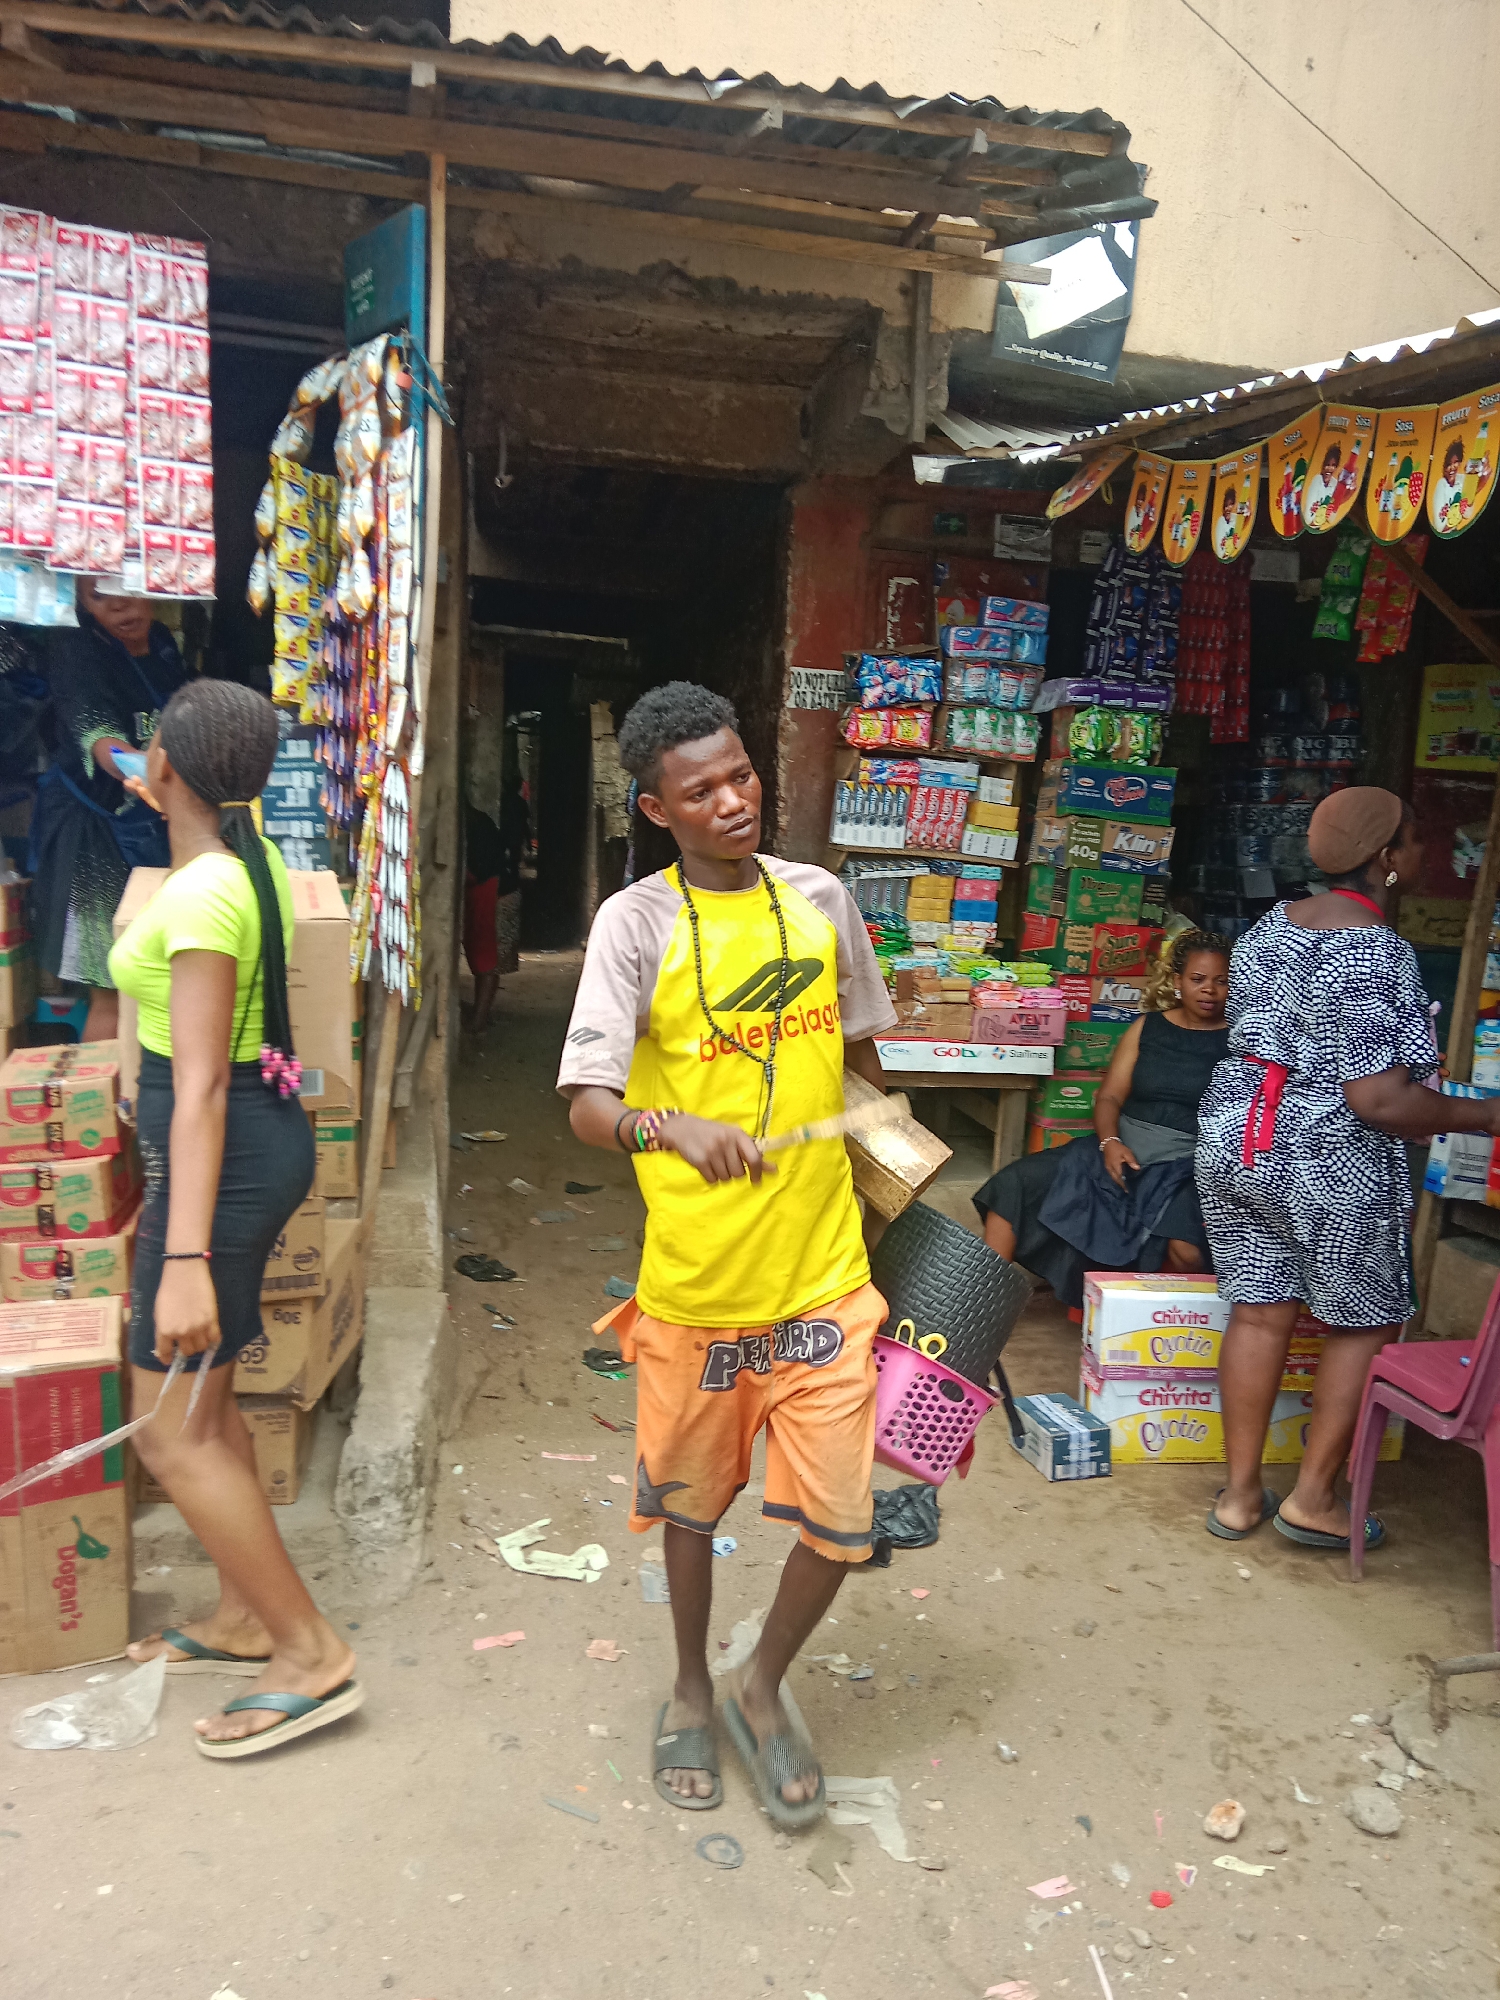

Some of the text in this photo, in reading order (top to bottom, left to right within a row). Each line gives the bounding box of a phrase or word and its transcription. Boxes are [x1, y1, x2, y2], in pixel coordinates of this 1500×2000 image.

[1442, 406, 1472, 426] FRUITY
[1068, 844, 1099, 861] 40g
[1112, 831, 1157, 854] Klin
[1098, 983, 1141, 1001] Klin
[1151, 1305, 1210, 1325] Chivita
[1150, 1330, 1212, 1364] exotic
[1138, 1381, 1212, 1406] Chivita
[1140, 1413, 1209, 1452] exotic
[52, 1545, 83, 1632] Dogan's
